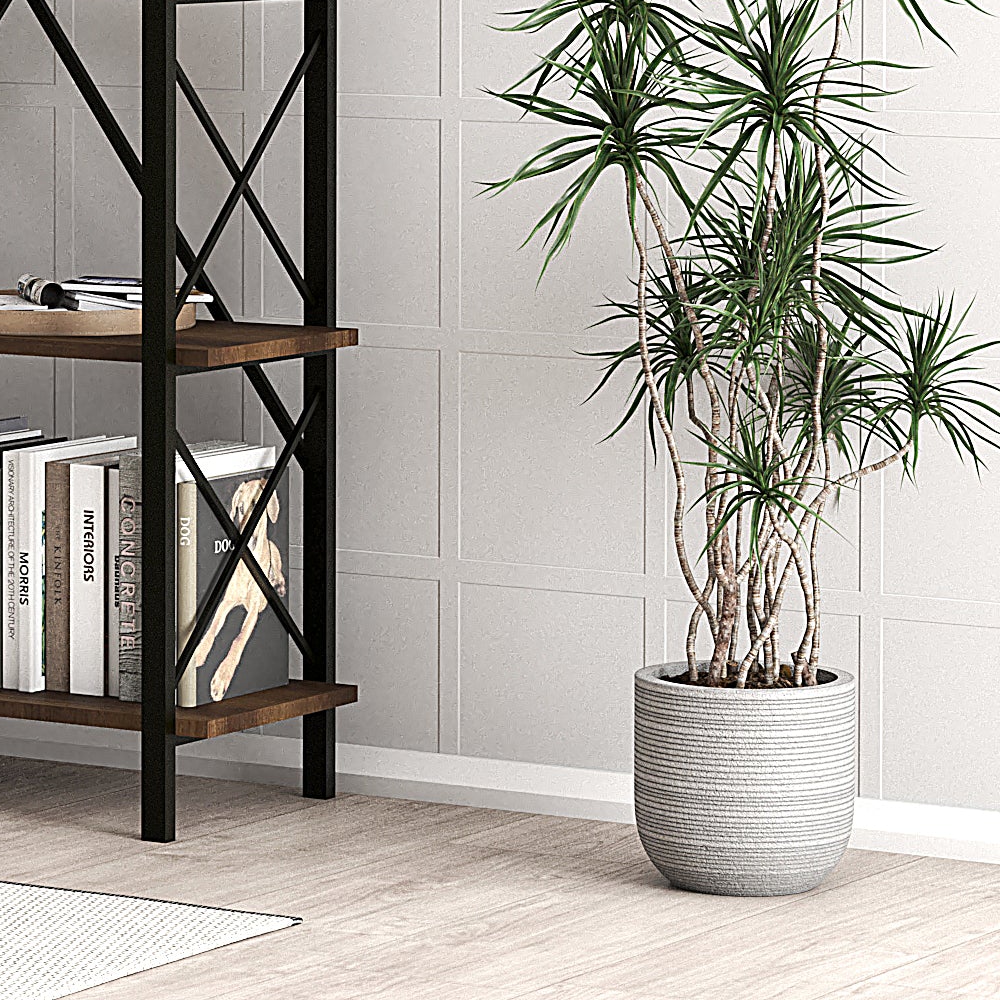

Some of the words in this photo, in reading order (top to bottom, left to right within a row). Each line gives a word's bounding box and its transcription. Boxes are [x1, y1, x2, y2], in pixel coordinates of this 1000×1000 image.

[8, 551, 15, 562] OF
[83, 509, 95, 582] INTERIORS
[180, 517, 190, 546] DOG
[19, 551, 29, 606] MORRIS
[120, 496, 136, 649] CONCRETE
